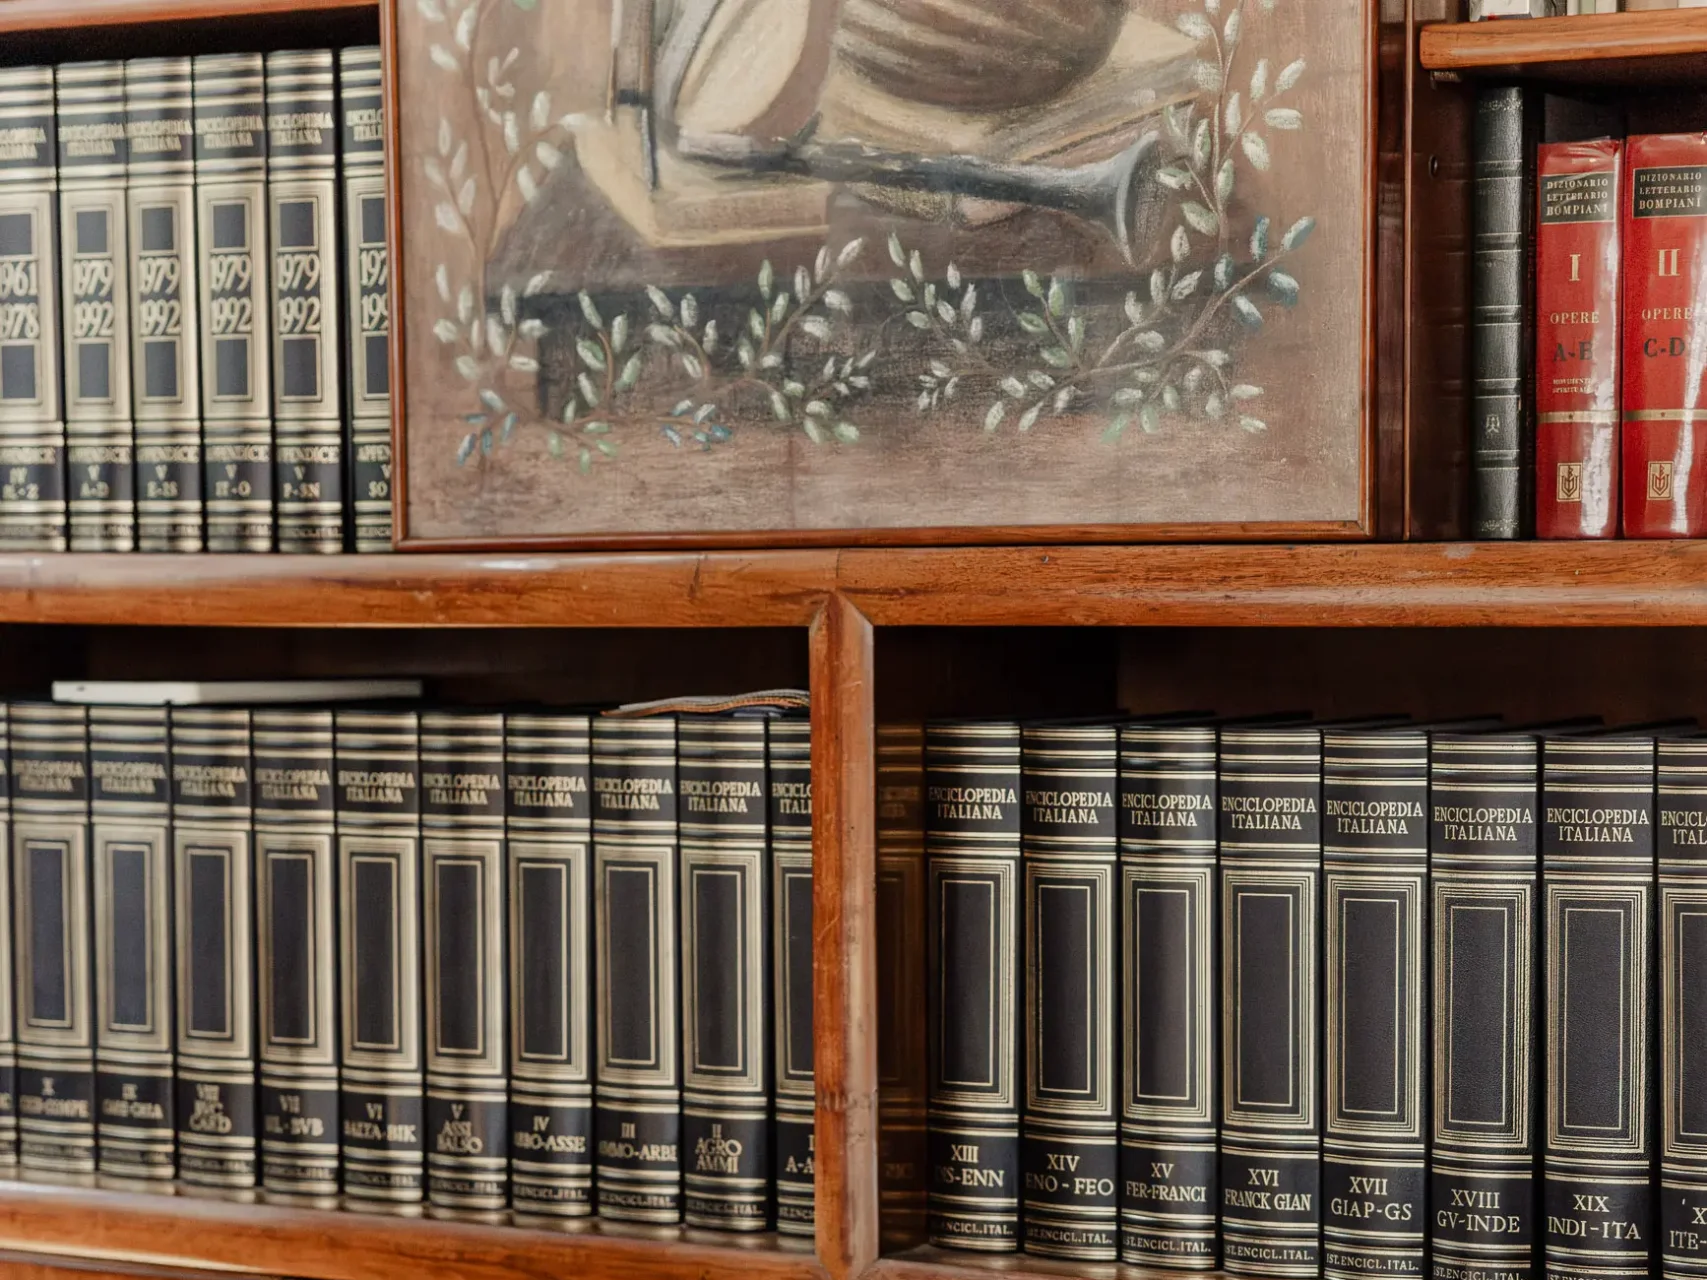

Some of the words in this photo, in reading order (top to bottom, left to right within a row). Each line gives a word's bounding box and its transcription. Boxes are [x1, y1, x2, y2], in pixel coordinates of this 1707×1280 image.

[1547, 178, 1608, 189] DIZIONARIO
[1640, 172, 1702, 182] DIZIONARIO
[1547, 192, 1608, 202] LETTERARIO
[1640, 185, 1701, 195] LETTERARIO
[1546, 204, 1608, 216] BOMPIANI
[1640, 198, 1701, 209] BOMPIANI
[1569, 254, 1581, 281] I
[1659, 249, 1680, 276] II
[0, 260, 38, 299] 961
[139, 257, 180, 295] 1979
[210, 254, 251, 292] 1979
[277, 254, 320, 291] 1979
[0, 302, 39, 339] 978
[140, 299, 181, 335] 1992
[211, 297, 252, 334] 1992
[278, 296, 321, 333] 1992
[1550, 312, 1599, 324] OPERE
[1642, 308, 1692, 320] OPERE
[1644, 337, 1685, 357] C-D
[680, 780, 762, 796] ENCICLOPEDIA
[929, 787, 1017, 803] ENCICLOPEDIA
[601, 794, 660, 810] ITALIANA
[688, 797, 748, 813] ITALIANA
[1026, 791, 1113, 807] ENCICLOPEDIA
[1122, 794, 1213, 810] ENCICLOPEDIA
[1222, 796, 1316, 813] ENCICLOPEDIA
[938, 804, 1002, 819] ITALIANA
[1034, 808, 1099, 823] ITALIANA
[1326, 800, 1423, 817] ENCICLOPEDIA
[1434, 807, 1533, 824] ENCICLOPEDIA
[1547, 808, 1649, 824] ENCICLOPEDIA
[1131, 811, 1197, 826] ITALIANA
[1232, 814, 1302, 830] ITALIANA
[1338, 818, 1408, 834] ITALIANA
[1661, 811, 1707, 826] ENCICL
[1445, 825, 1517, 841] ITALIANA
[1559, 826, 1633, 842] ITALIANA
[366, 1103, 382, 1120] VI
[452, 1104, 463, 1119] V
[533, 1116, 549, 1131] IV
[712, 1124, 722, 1138] II
[695, 1137, 742, 1157] AGRO
[952, 1145, 980, 1163] XIII
[1047, 1154, 1080, 1172] XIV
[1151, 1163, 1174, 1178] XV
[1248, 1168, 1279, 1186] XVI
[1126, 1181, 1206, 1202] FER-FRANCI
[1349, 1176, 1387, 1195] XVII
[1225, 1188, 1271, 1209] FRANCK
[1274, 1193, 1311, 1211] GIAN
[1451, 1189, 1500, 1208] XVIII
[1573, 1194, 1610, 1212] XIX
[1331, 1198, 1412, 1220] GIAP-GS
[1437, 1210, 1520, 1232] GV-INDE
[1326, 1253, 1419, 1270] IST.ENCICL.ITAL.
